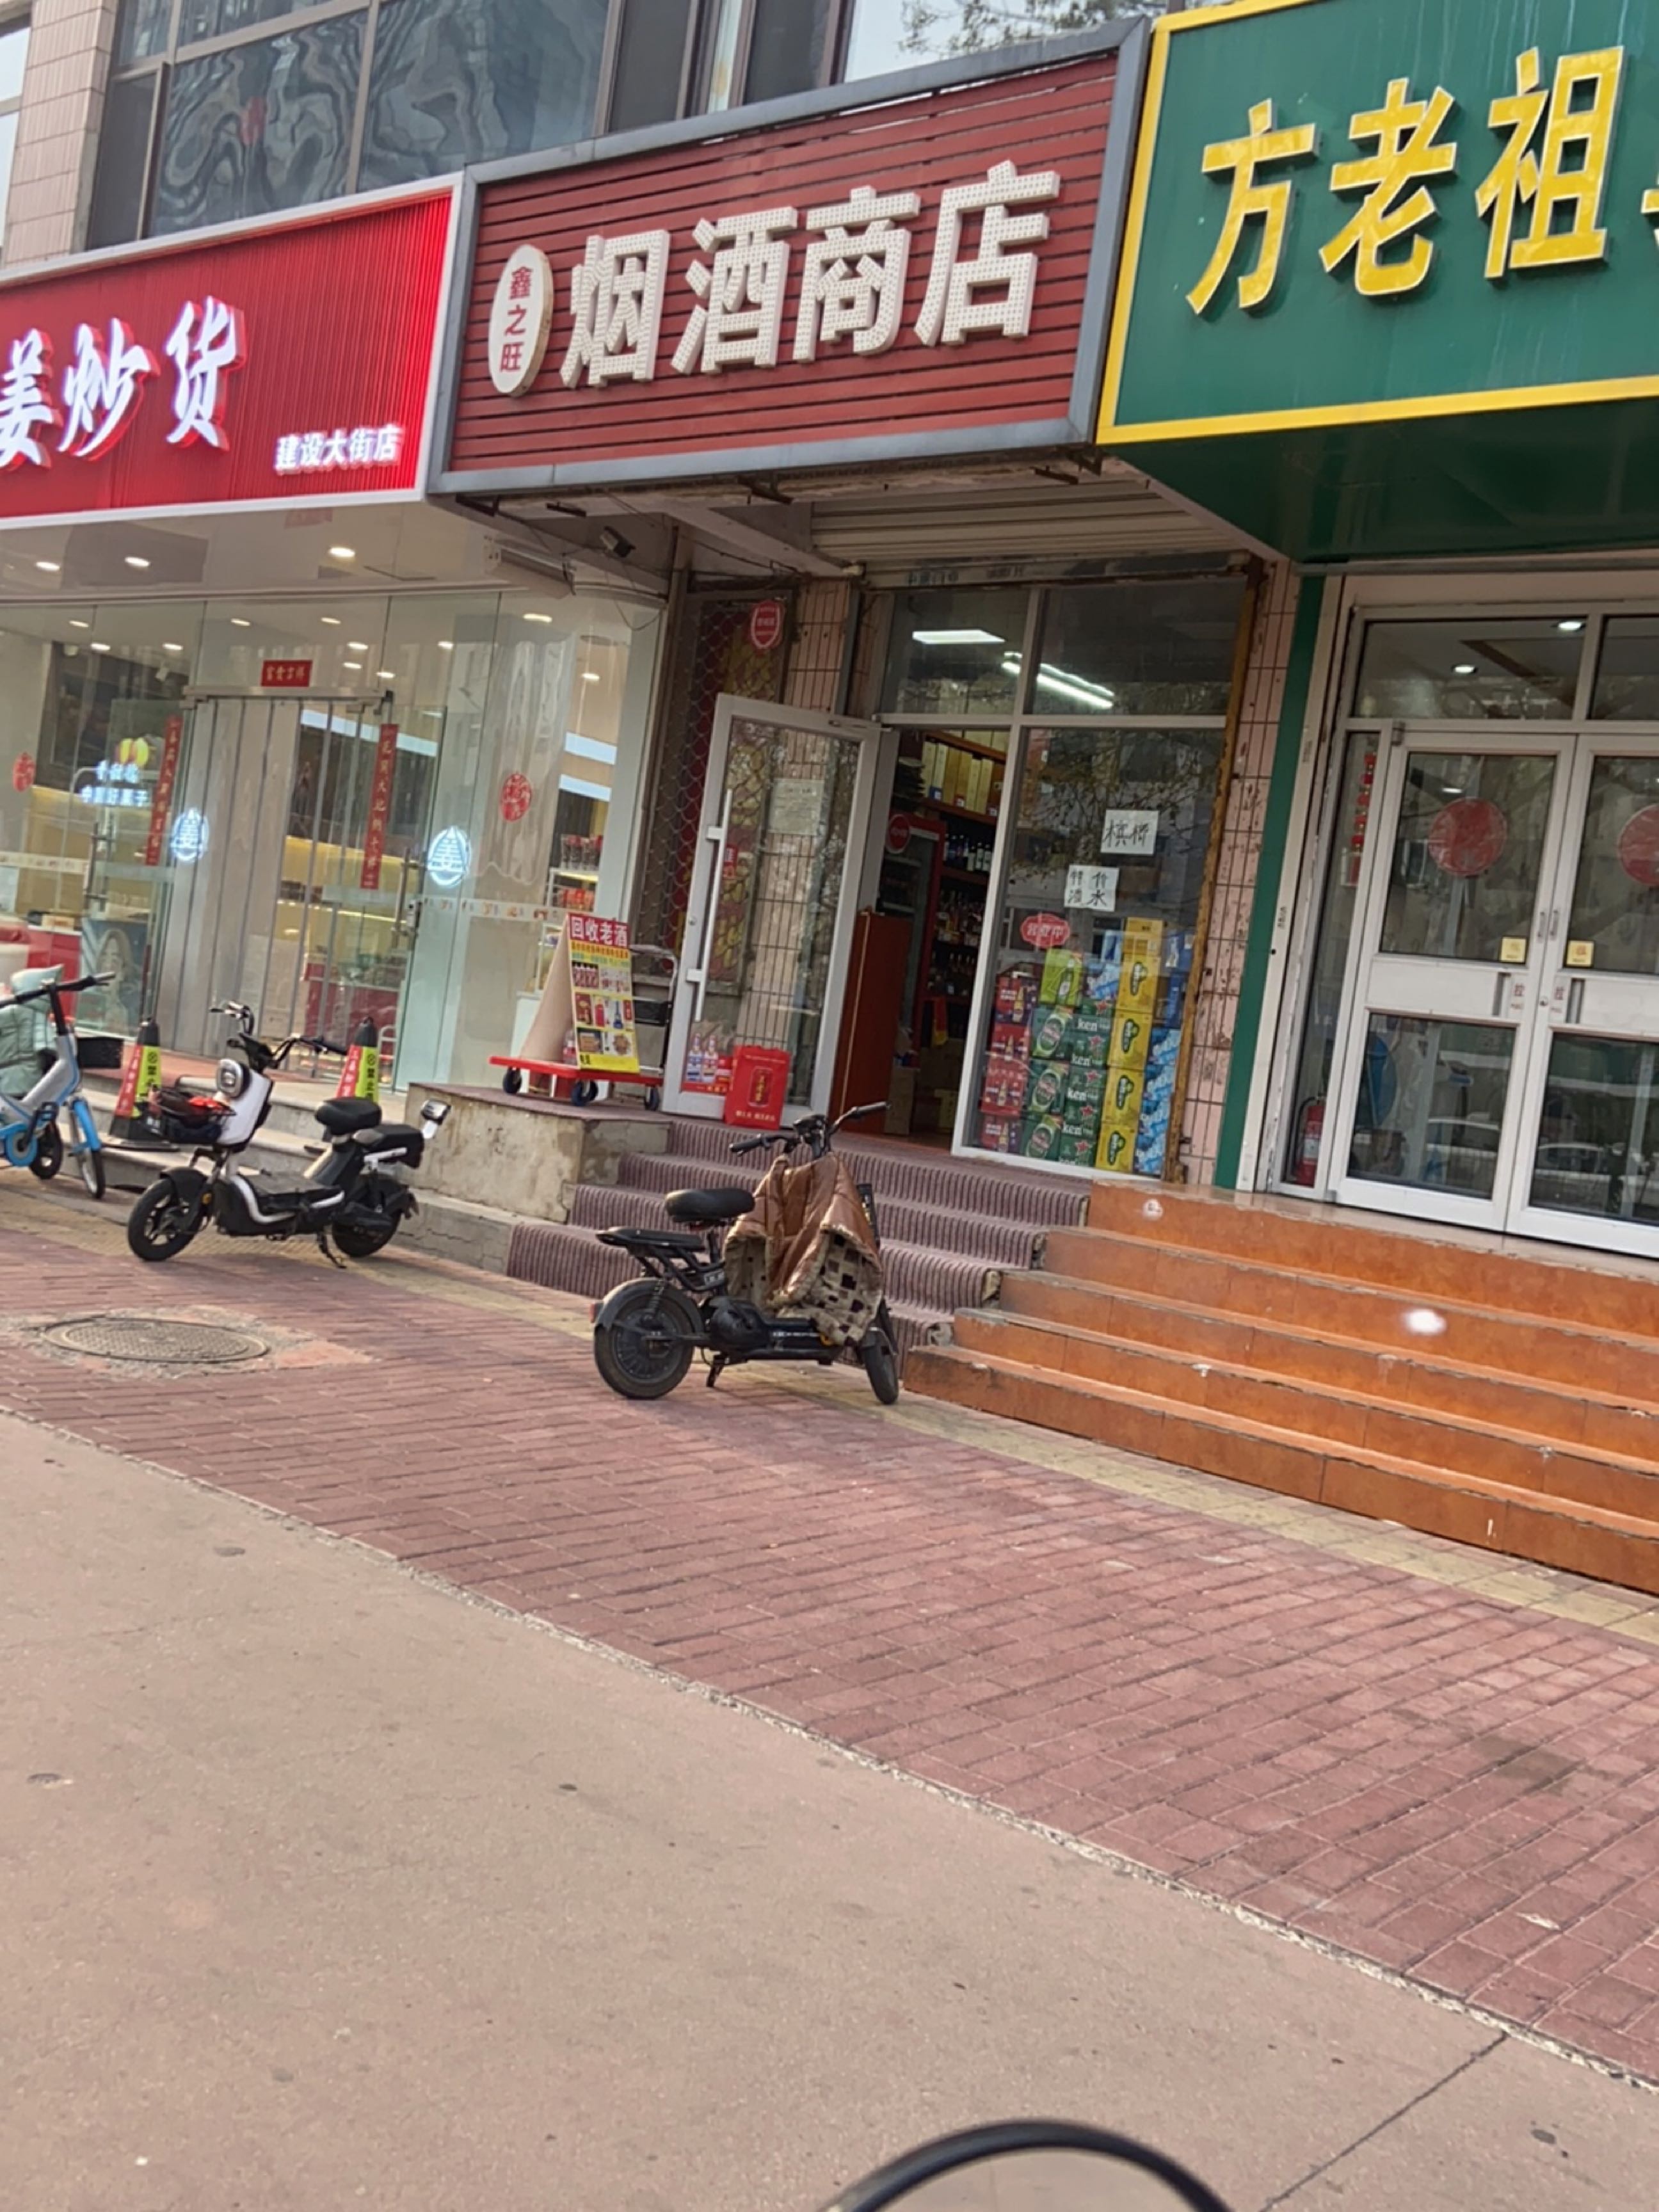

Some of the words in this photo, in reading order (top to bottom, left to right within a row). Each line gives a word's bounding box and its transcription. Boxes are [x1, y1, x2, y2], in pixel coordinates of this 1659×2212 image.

[1185, 45, 1659, 315] 方老祖
[499, 266, 534, 373] 鑫之旺
[559, 159, 1061, 389] 烟酒商店
[275, 422, 405, 472] 建设大街店
[571, 916, 629, 947] 回收老酒
